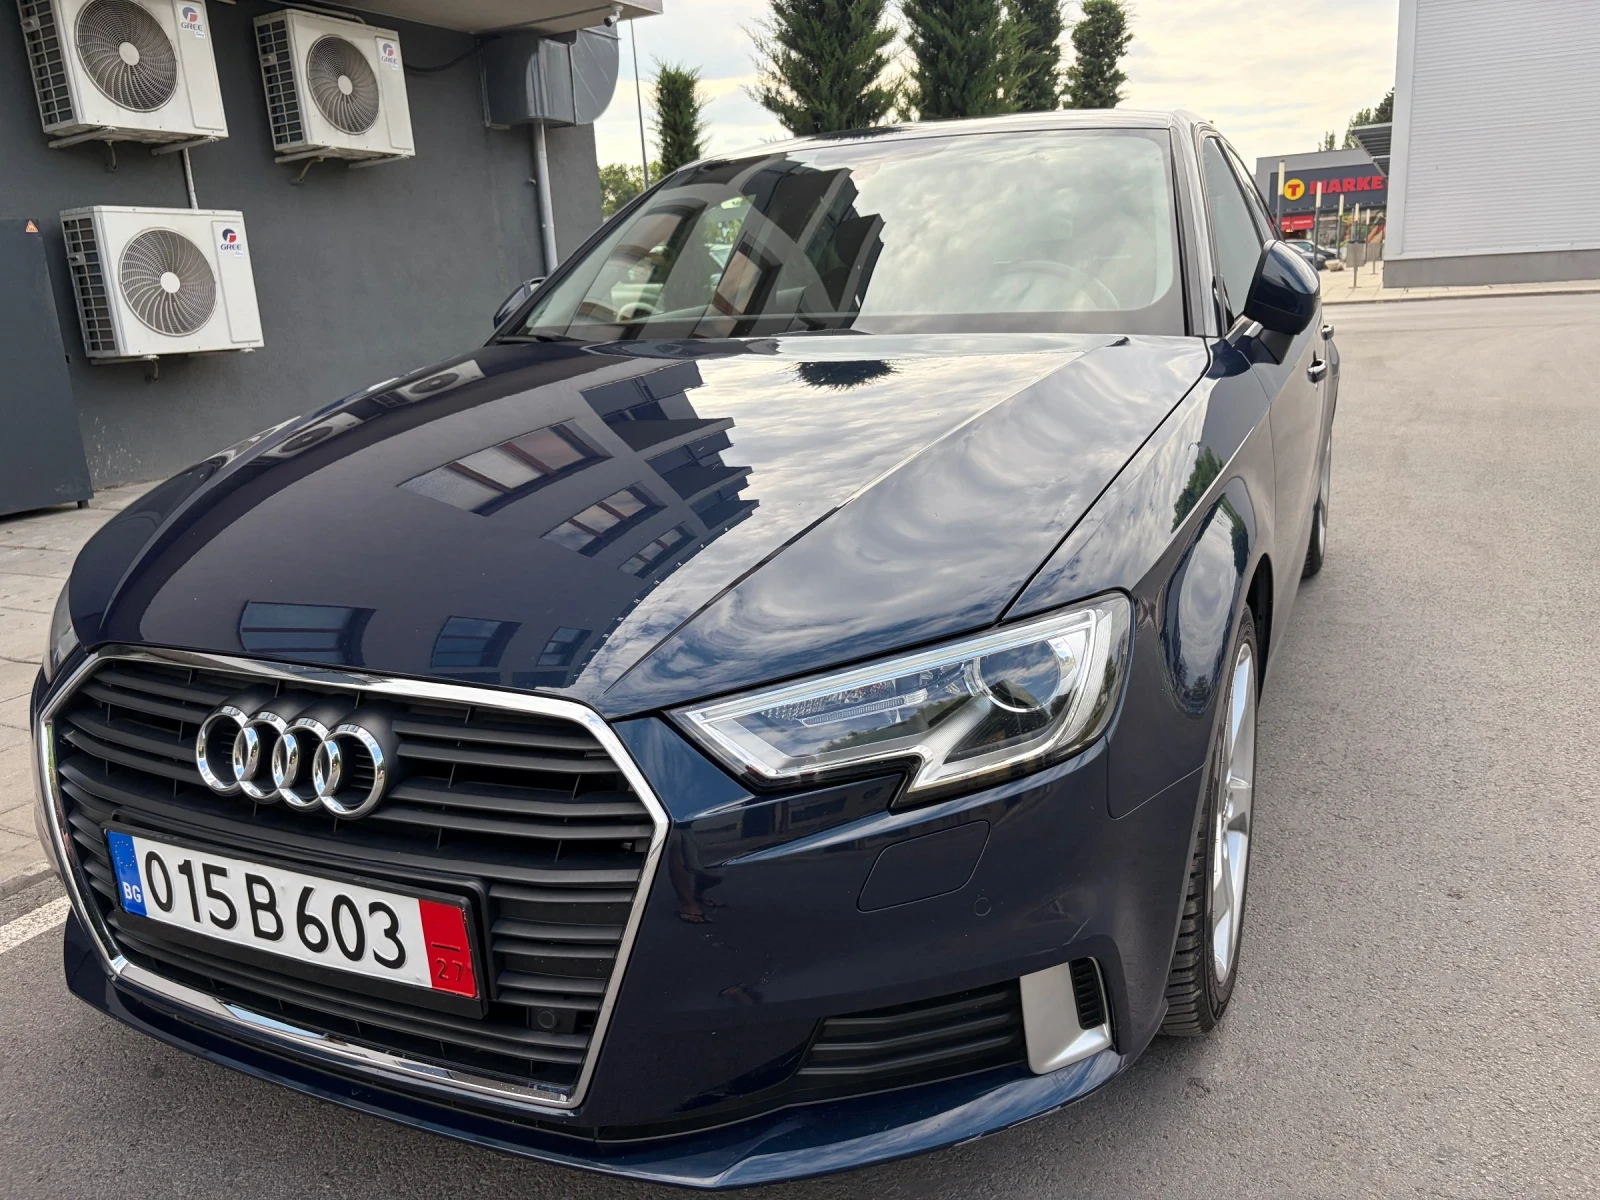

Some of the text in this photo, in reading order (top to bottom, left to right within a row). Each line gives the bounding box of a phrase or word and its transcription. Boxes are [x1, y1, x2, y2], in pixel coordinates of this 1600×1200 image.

[181, 21, 203, 31] GREE
[1288, 175, 1389, 197] T MARKE
[220, 243, 242, 251] GREE
[122, 881, 142, 903] BG
[436, 957, 464, 982] 27
